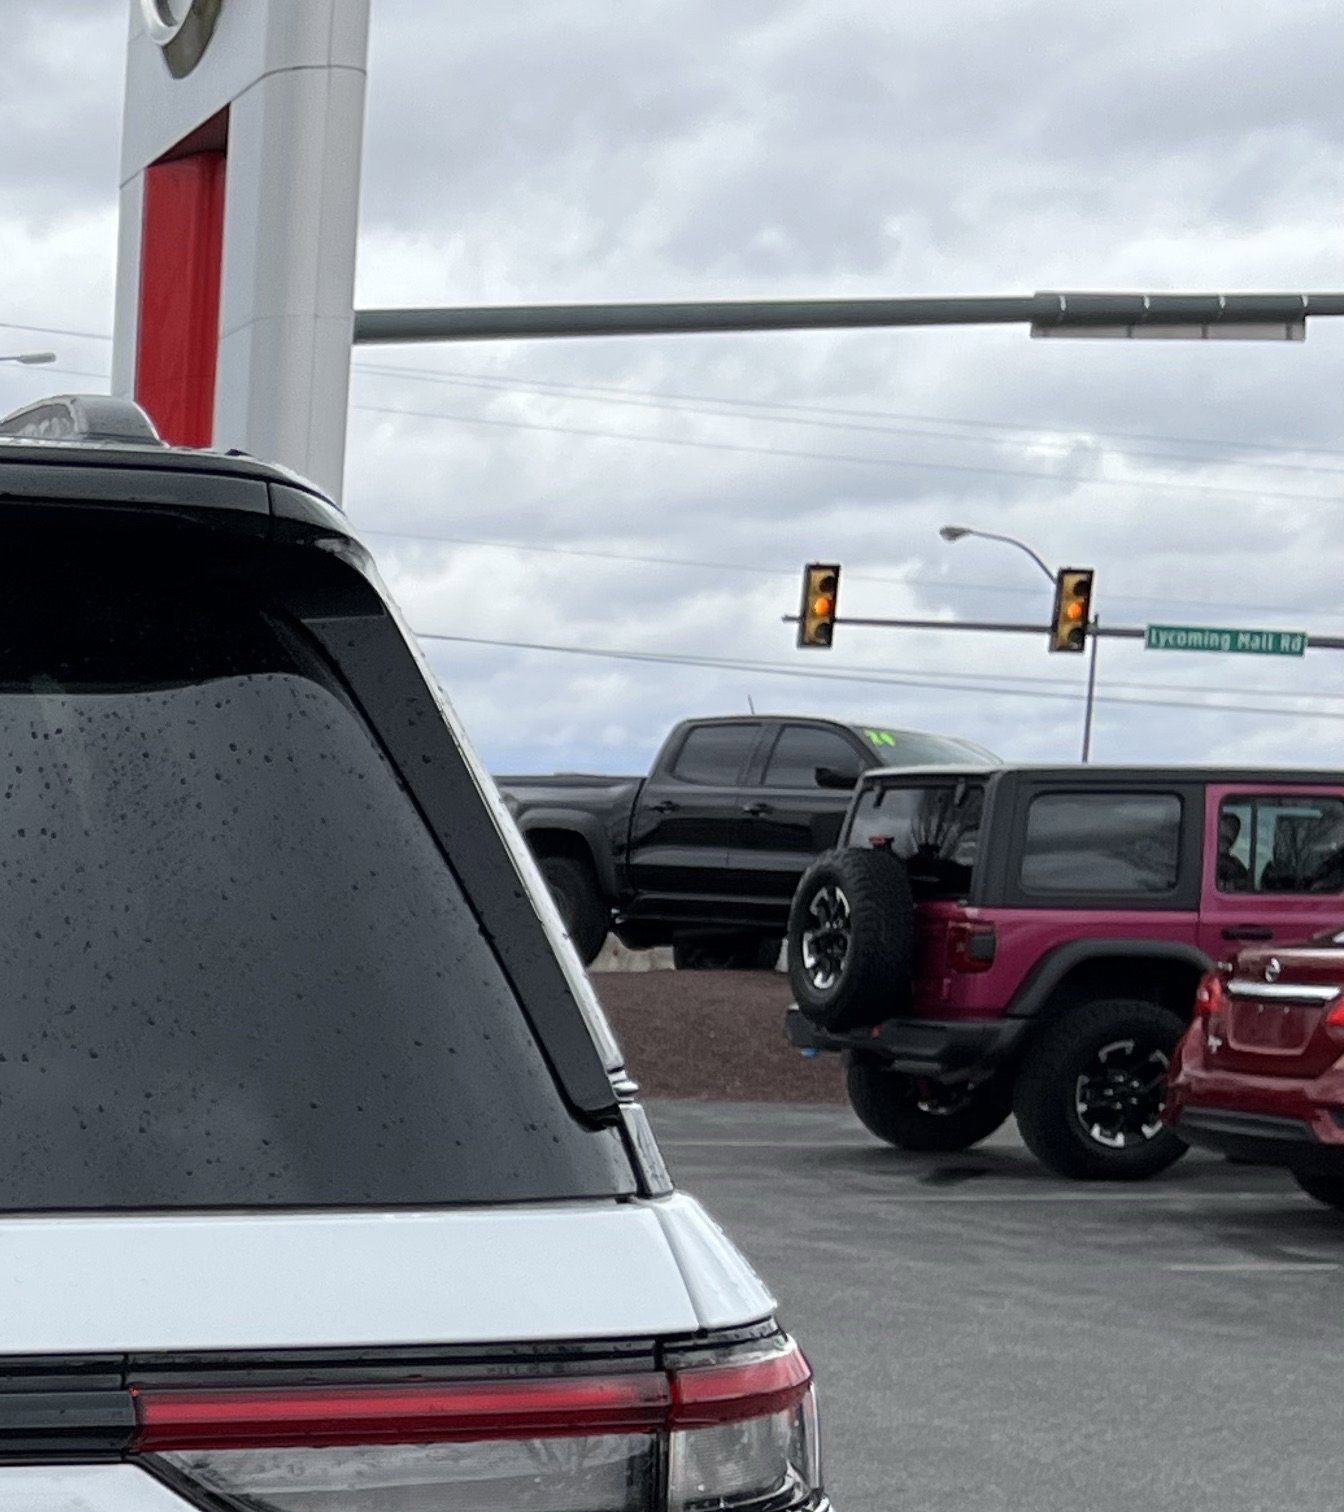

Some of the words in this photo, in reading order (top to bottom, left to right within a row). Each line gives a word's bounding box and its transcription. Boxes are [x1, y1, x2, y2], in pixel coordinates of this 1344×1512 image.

[1150, 627, 1232, 651] Lycoming
[1237, 631, 1274, 651] Mall
[1280, 633, 1302, 652] Rd
